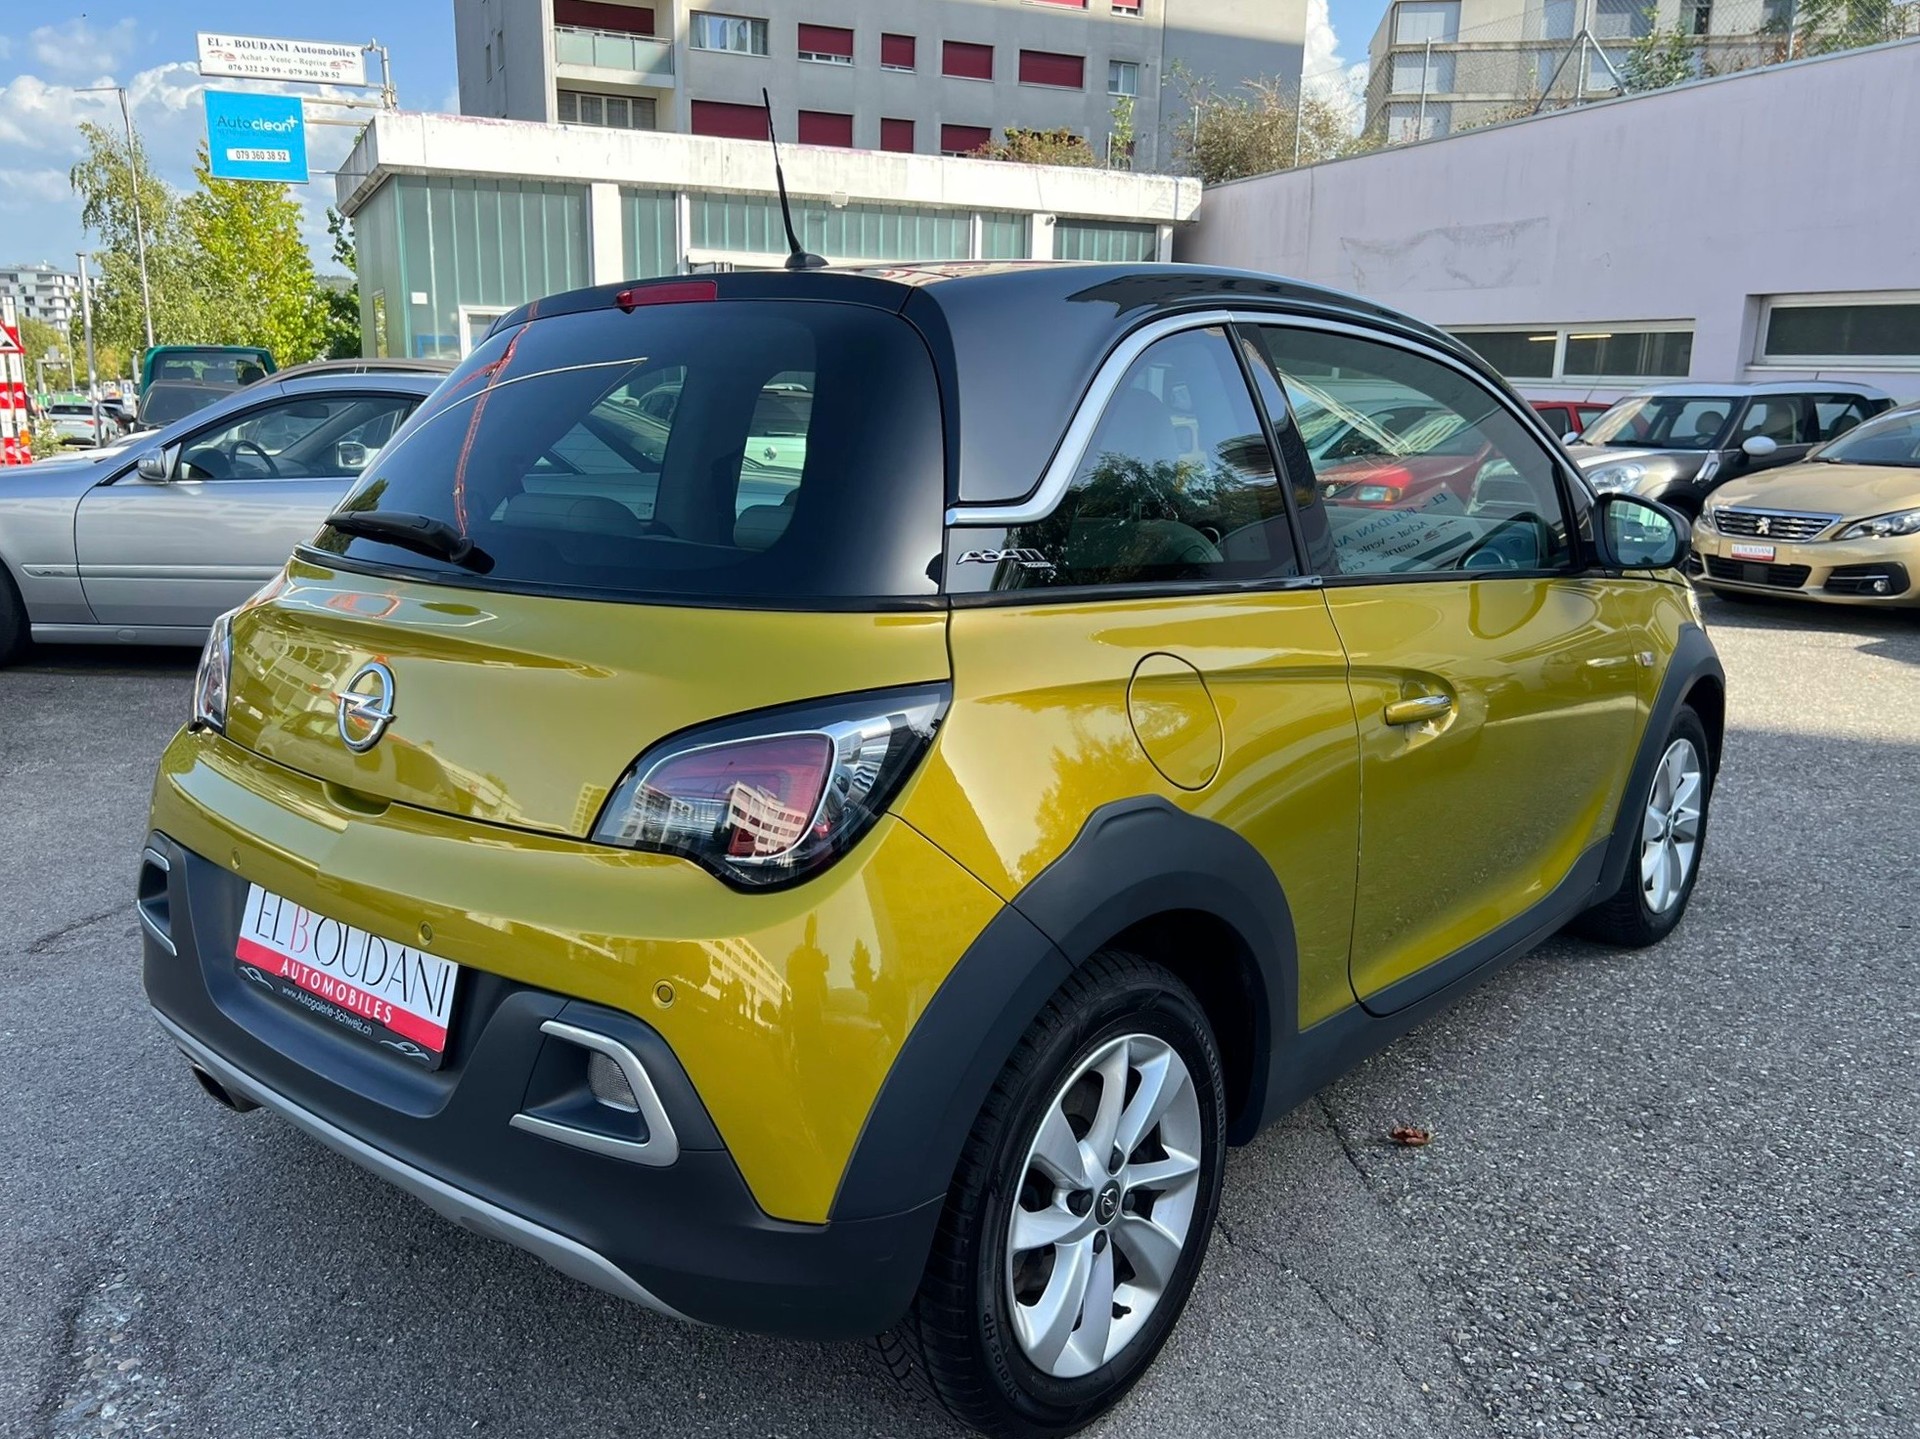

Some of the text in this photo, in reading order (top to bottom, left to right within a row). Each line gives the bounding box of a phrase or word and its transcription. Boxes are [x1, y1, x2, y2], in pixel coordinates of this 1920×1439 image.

[208, 37, 222, 46] EL
[234, 39, 289, 52] BOUDANI
[293, 45, 356, 58] Automobiles
[299, 58, 327, 66] Reprise
[236, 150, 287, 161] 079 360 38 52
[280, 958, 392, 1024] AUTOMOBILES
[282, 986, 373, 1036] www.Autogalerie-Schweiz.ch
